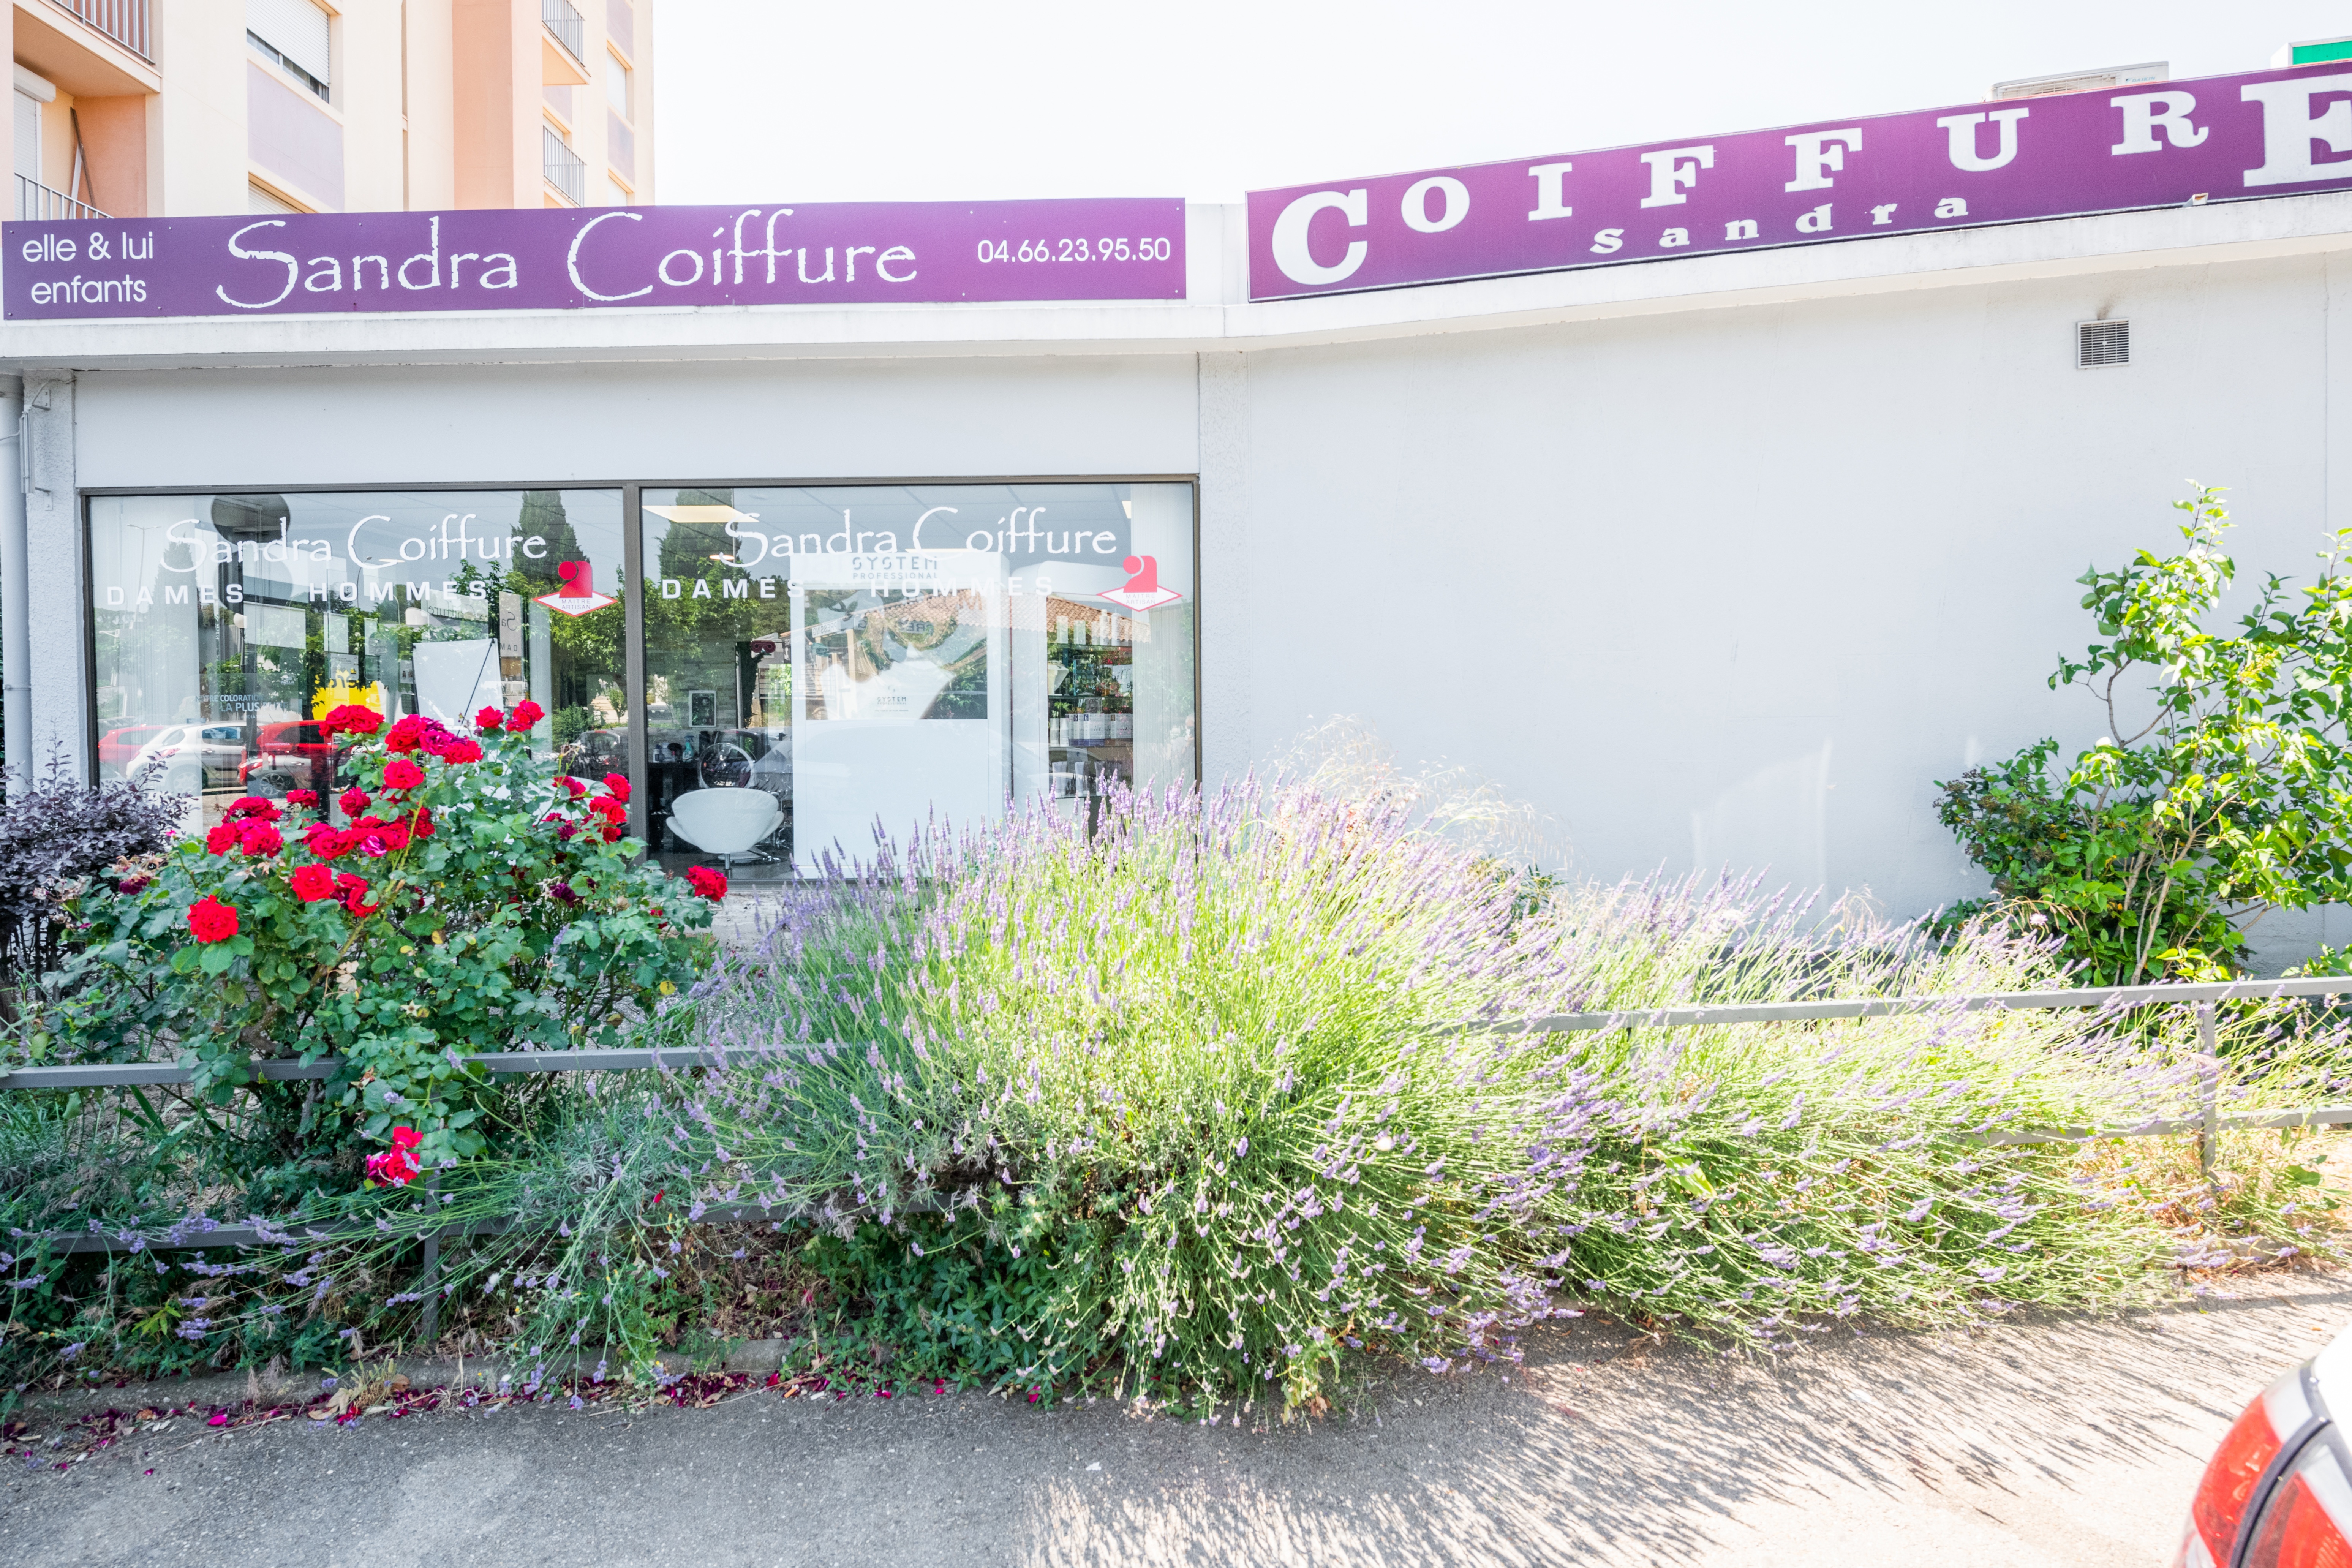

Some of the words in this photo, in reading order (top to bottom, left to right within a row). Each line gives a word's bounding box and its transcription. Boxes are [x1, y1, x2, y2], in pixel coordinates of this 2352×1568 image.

[1272, 73, 2352, 285] COIFFURE
[1590, 198, 1968, 254] sandra
[22, 234, 76, 262] elle
[88, 232, 111, 260] &
[122, 231, 153, 259] lui
[216, 216, 518, 308] Sandra
[567, 208, 917, 302] Coiffure
[978, 237, 1171, 263] 04.66.23.95.50
[31, 274, 147, 304] enfants
[161, 516, 332, 572] Sandra
[348, 514, 547, 569] Coiffure
[719, 509, 898, 568] Sandra
[913, 506, 1116, 561] Coiffure
[852, 556, 937, 570] SYSTEM
[107, 584, 243, 605] DAMES
[309, 581, 487, 602] HOMMES
[662, 579, 805, 599] DAMES
[871, 577, 1053, 597] HOMMES
[221, 702, 232, 711] LA
[235, 702, 260, 712] PLUS
